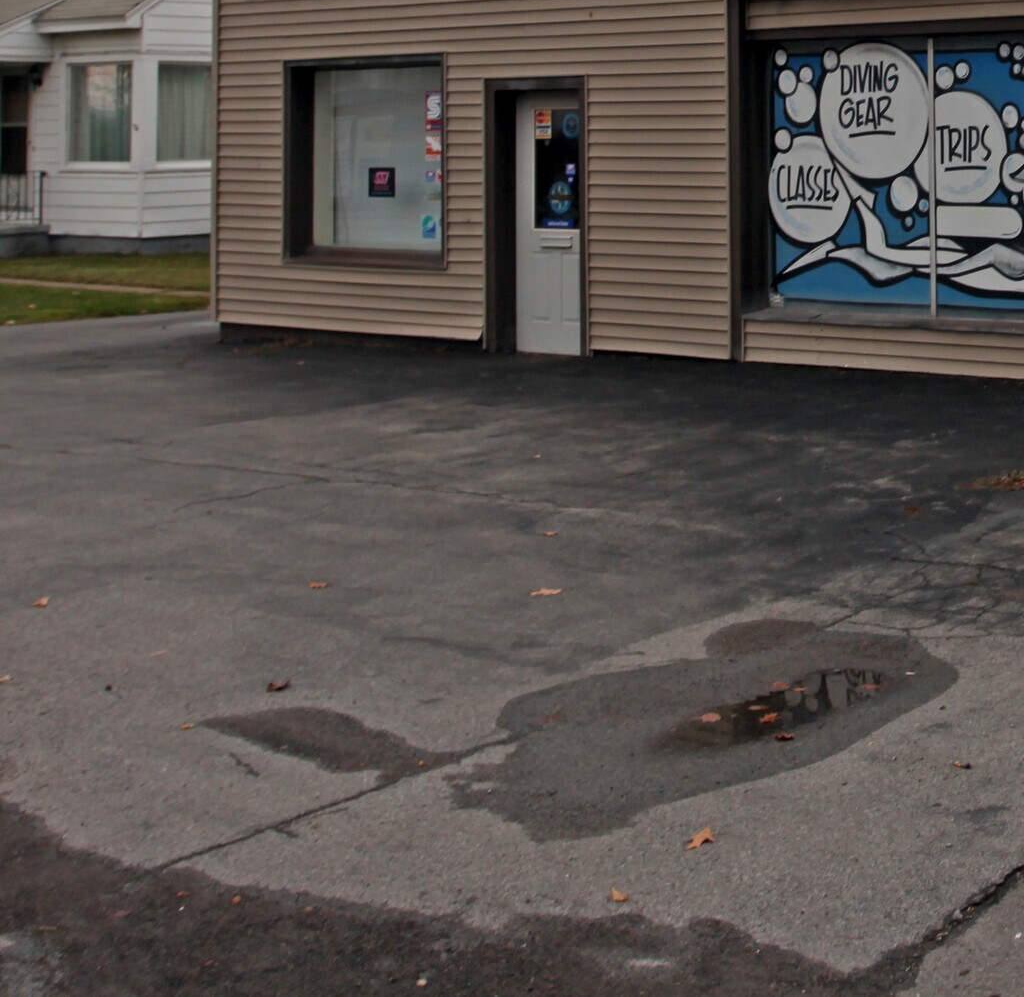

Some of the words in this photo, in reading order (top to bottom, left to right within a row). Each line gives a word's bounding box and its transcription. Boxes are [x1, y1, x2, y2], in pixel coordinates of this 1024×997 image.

[840, 61, 899, 96] DIVING
[838, 97, 894, 130] GEAR
[936, 125, 992, 164] TRIPS
[776, 163, 840, 203] CLASSES
